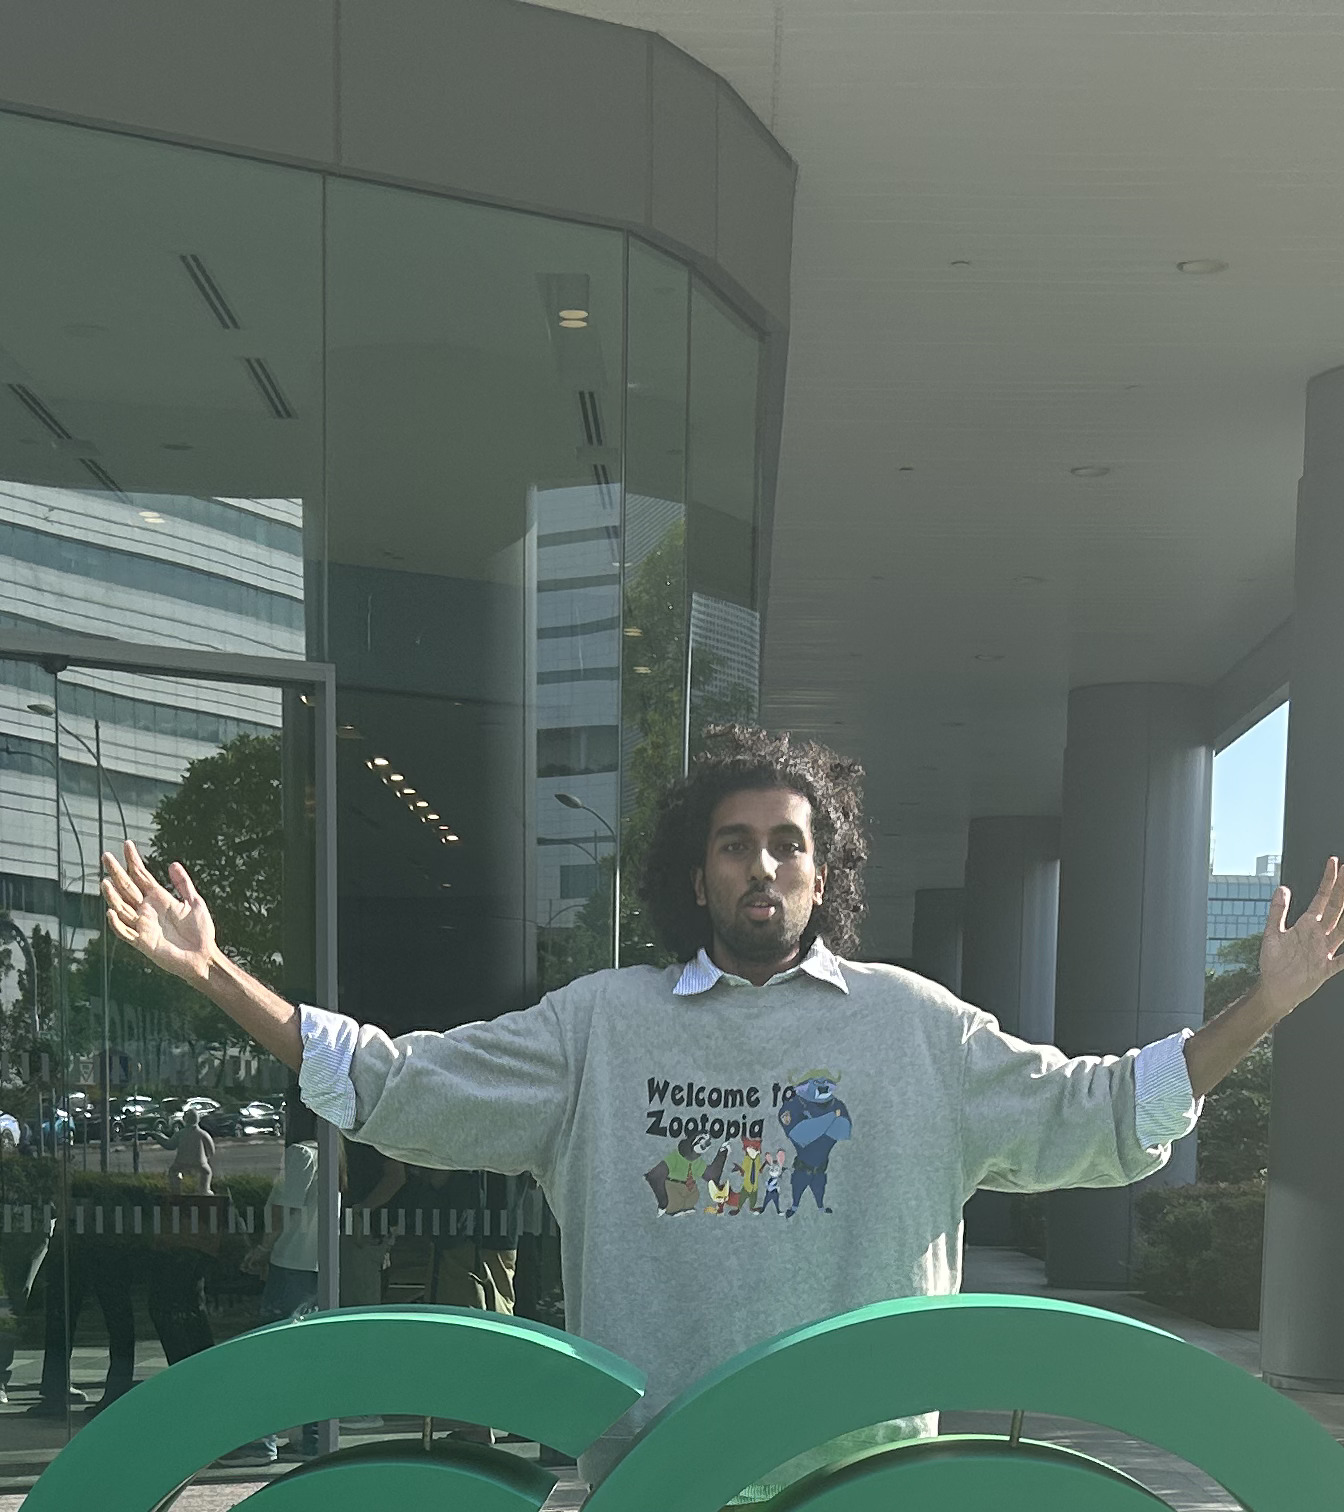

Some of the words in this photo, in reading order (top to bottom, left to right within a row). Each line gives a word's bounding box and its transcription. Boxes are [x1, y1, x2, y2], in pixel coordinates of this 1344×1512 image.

[647, 1076, 761, 1108] Welcome
[772, 1082, 796, 1107] to
[645, 1109, 765, 1142] Zootopia
